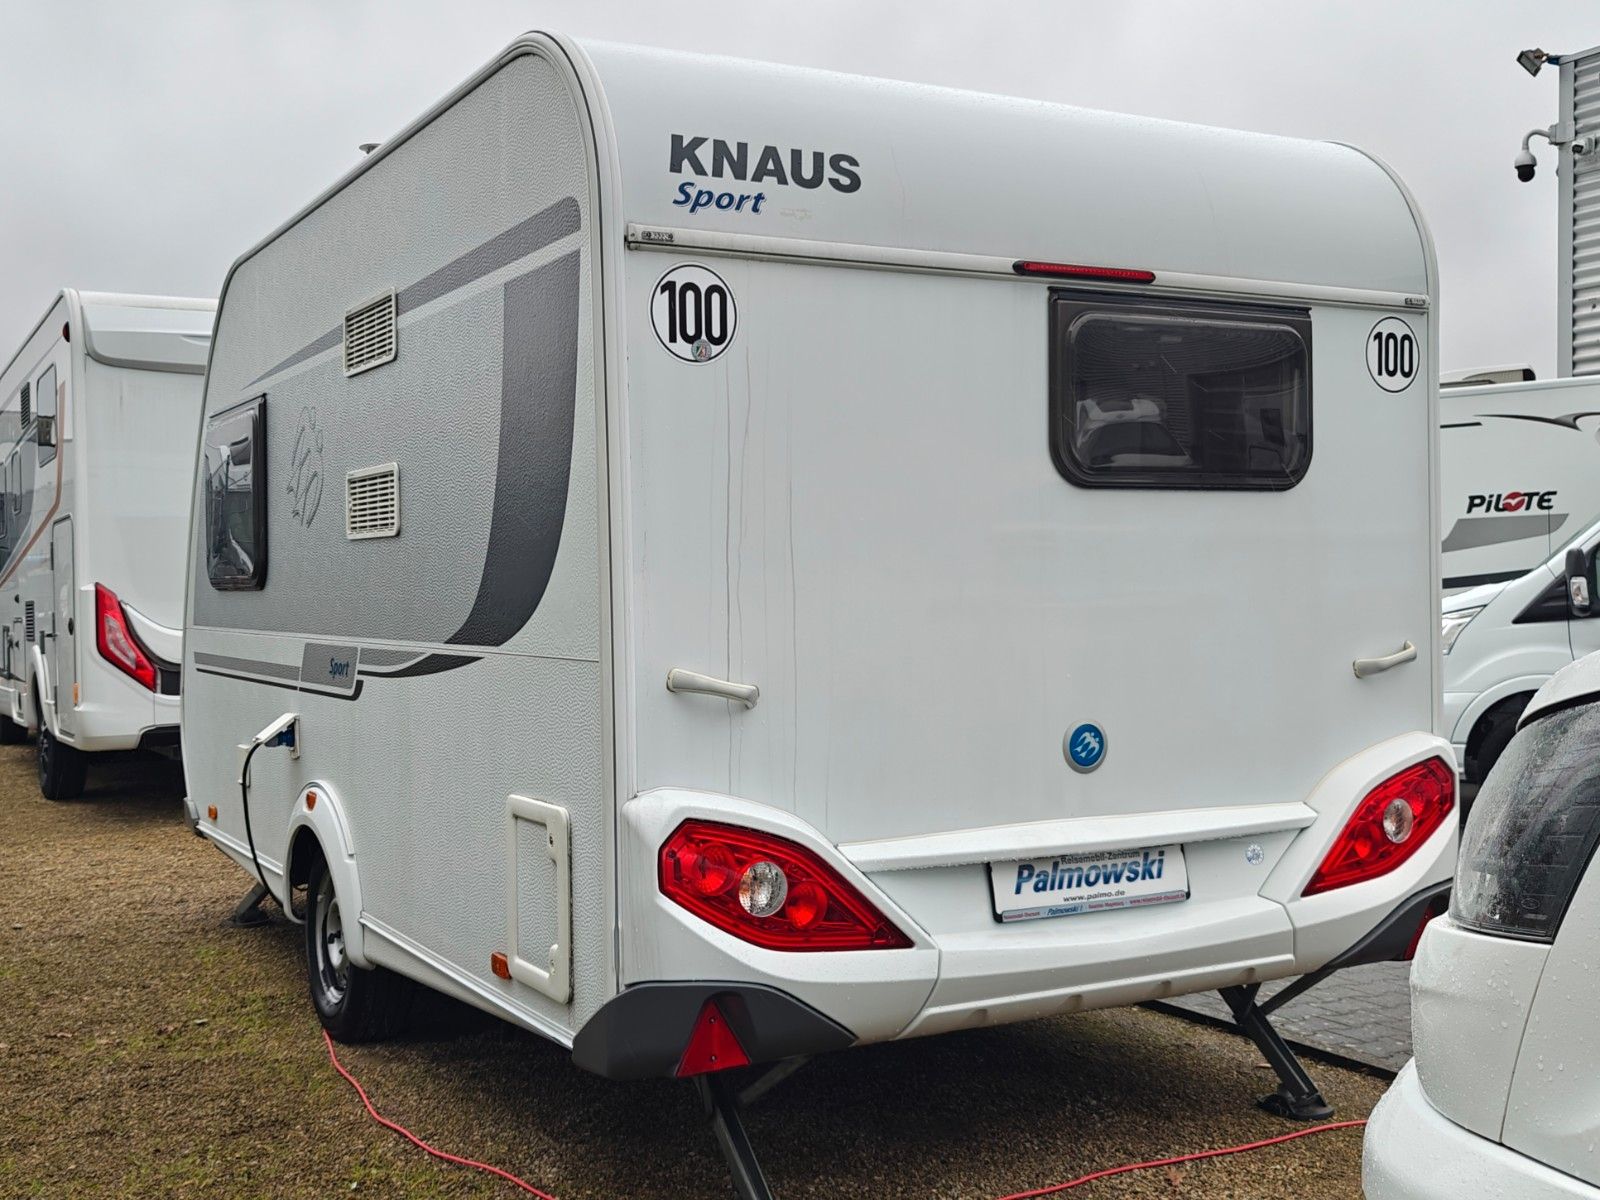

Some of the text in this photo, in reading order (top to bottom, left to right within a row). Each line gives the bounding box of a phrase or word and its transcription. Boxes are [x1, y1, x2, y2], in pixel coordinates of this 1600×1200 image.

[669, 134, 861, 193] KNAUS
[672, 181, 766, 215] Sport
[660, 280, 728, 346] 100
[1373, 331, 1414, 378] 100
[328, 657, 349, 679] Sport
[1014, 850, 1165, 895] Palmowski
[1063, 889, 1126, 903] www.palmo.de
